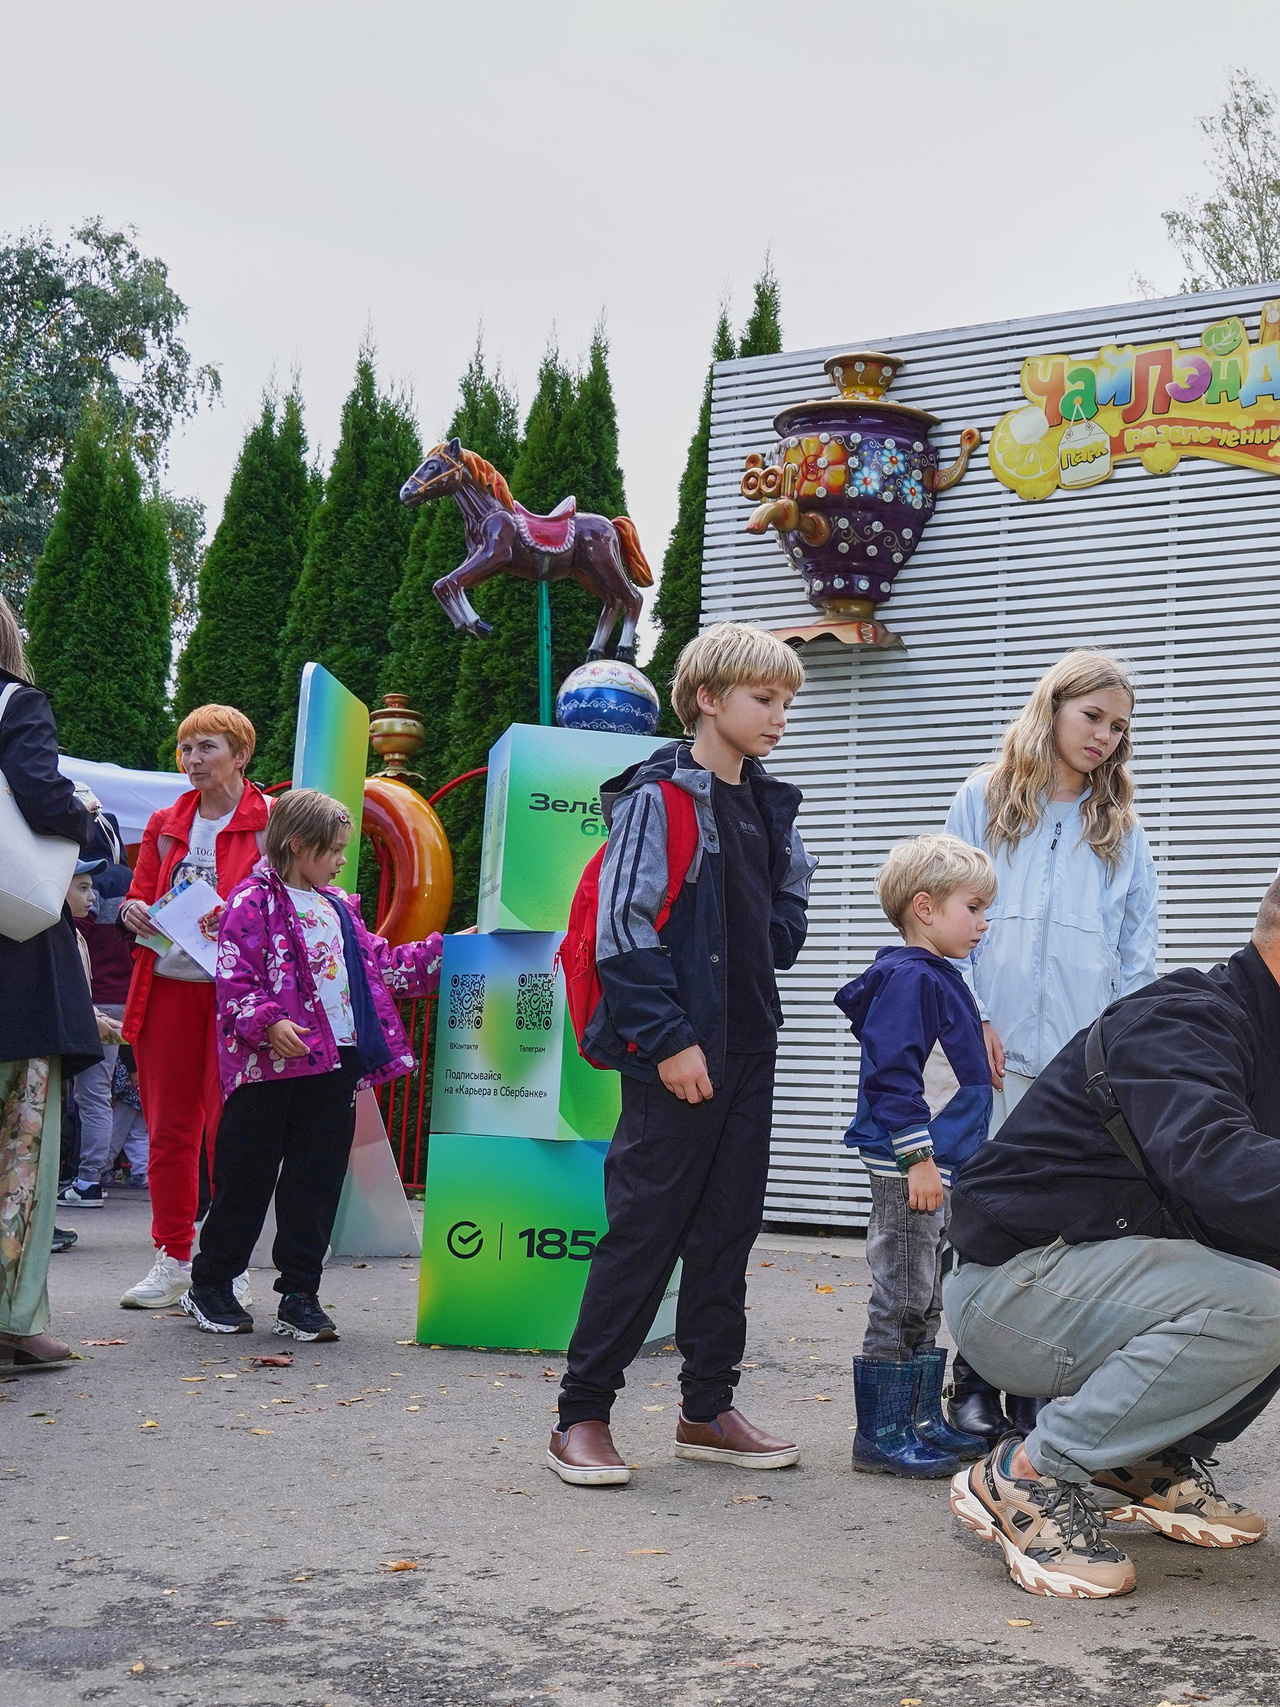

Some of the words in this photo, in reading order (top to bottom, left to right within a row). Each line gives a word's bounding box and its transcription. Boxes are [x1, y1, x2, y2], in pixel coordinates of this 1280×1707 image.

[449, 1042, 479, 1051] ВКонтакте
[519, 1044, 546, 1055] Телеграм
[445, 1069, 502, 1081] Подписывайся
[444, 1086, 453, 1094] на
[455, 1085, 491, 1097] «Карьера
[499, 1086, 548, 1098] Сбербанке»
[518, 1228, 596, 1261] 185
[986, 1467, 994, 1491] FILA
